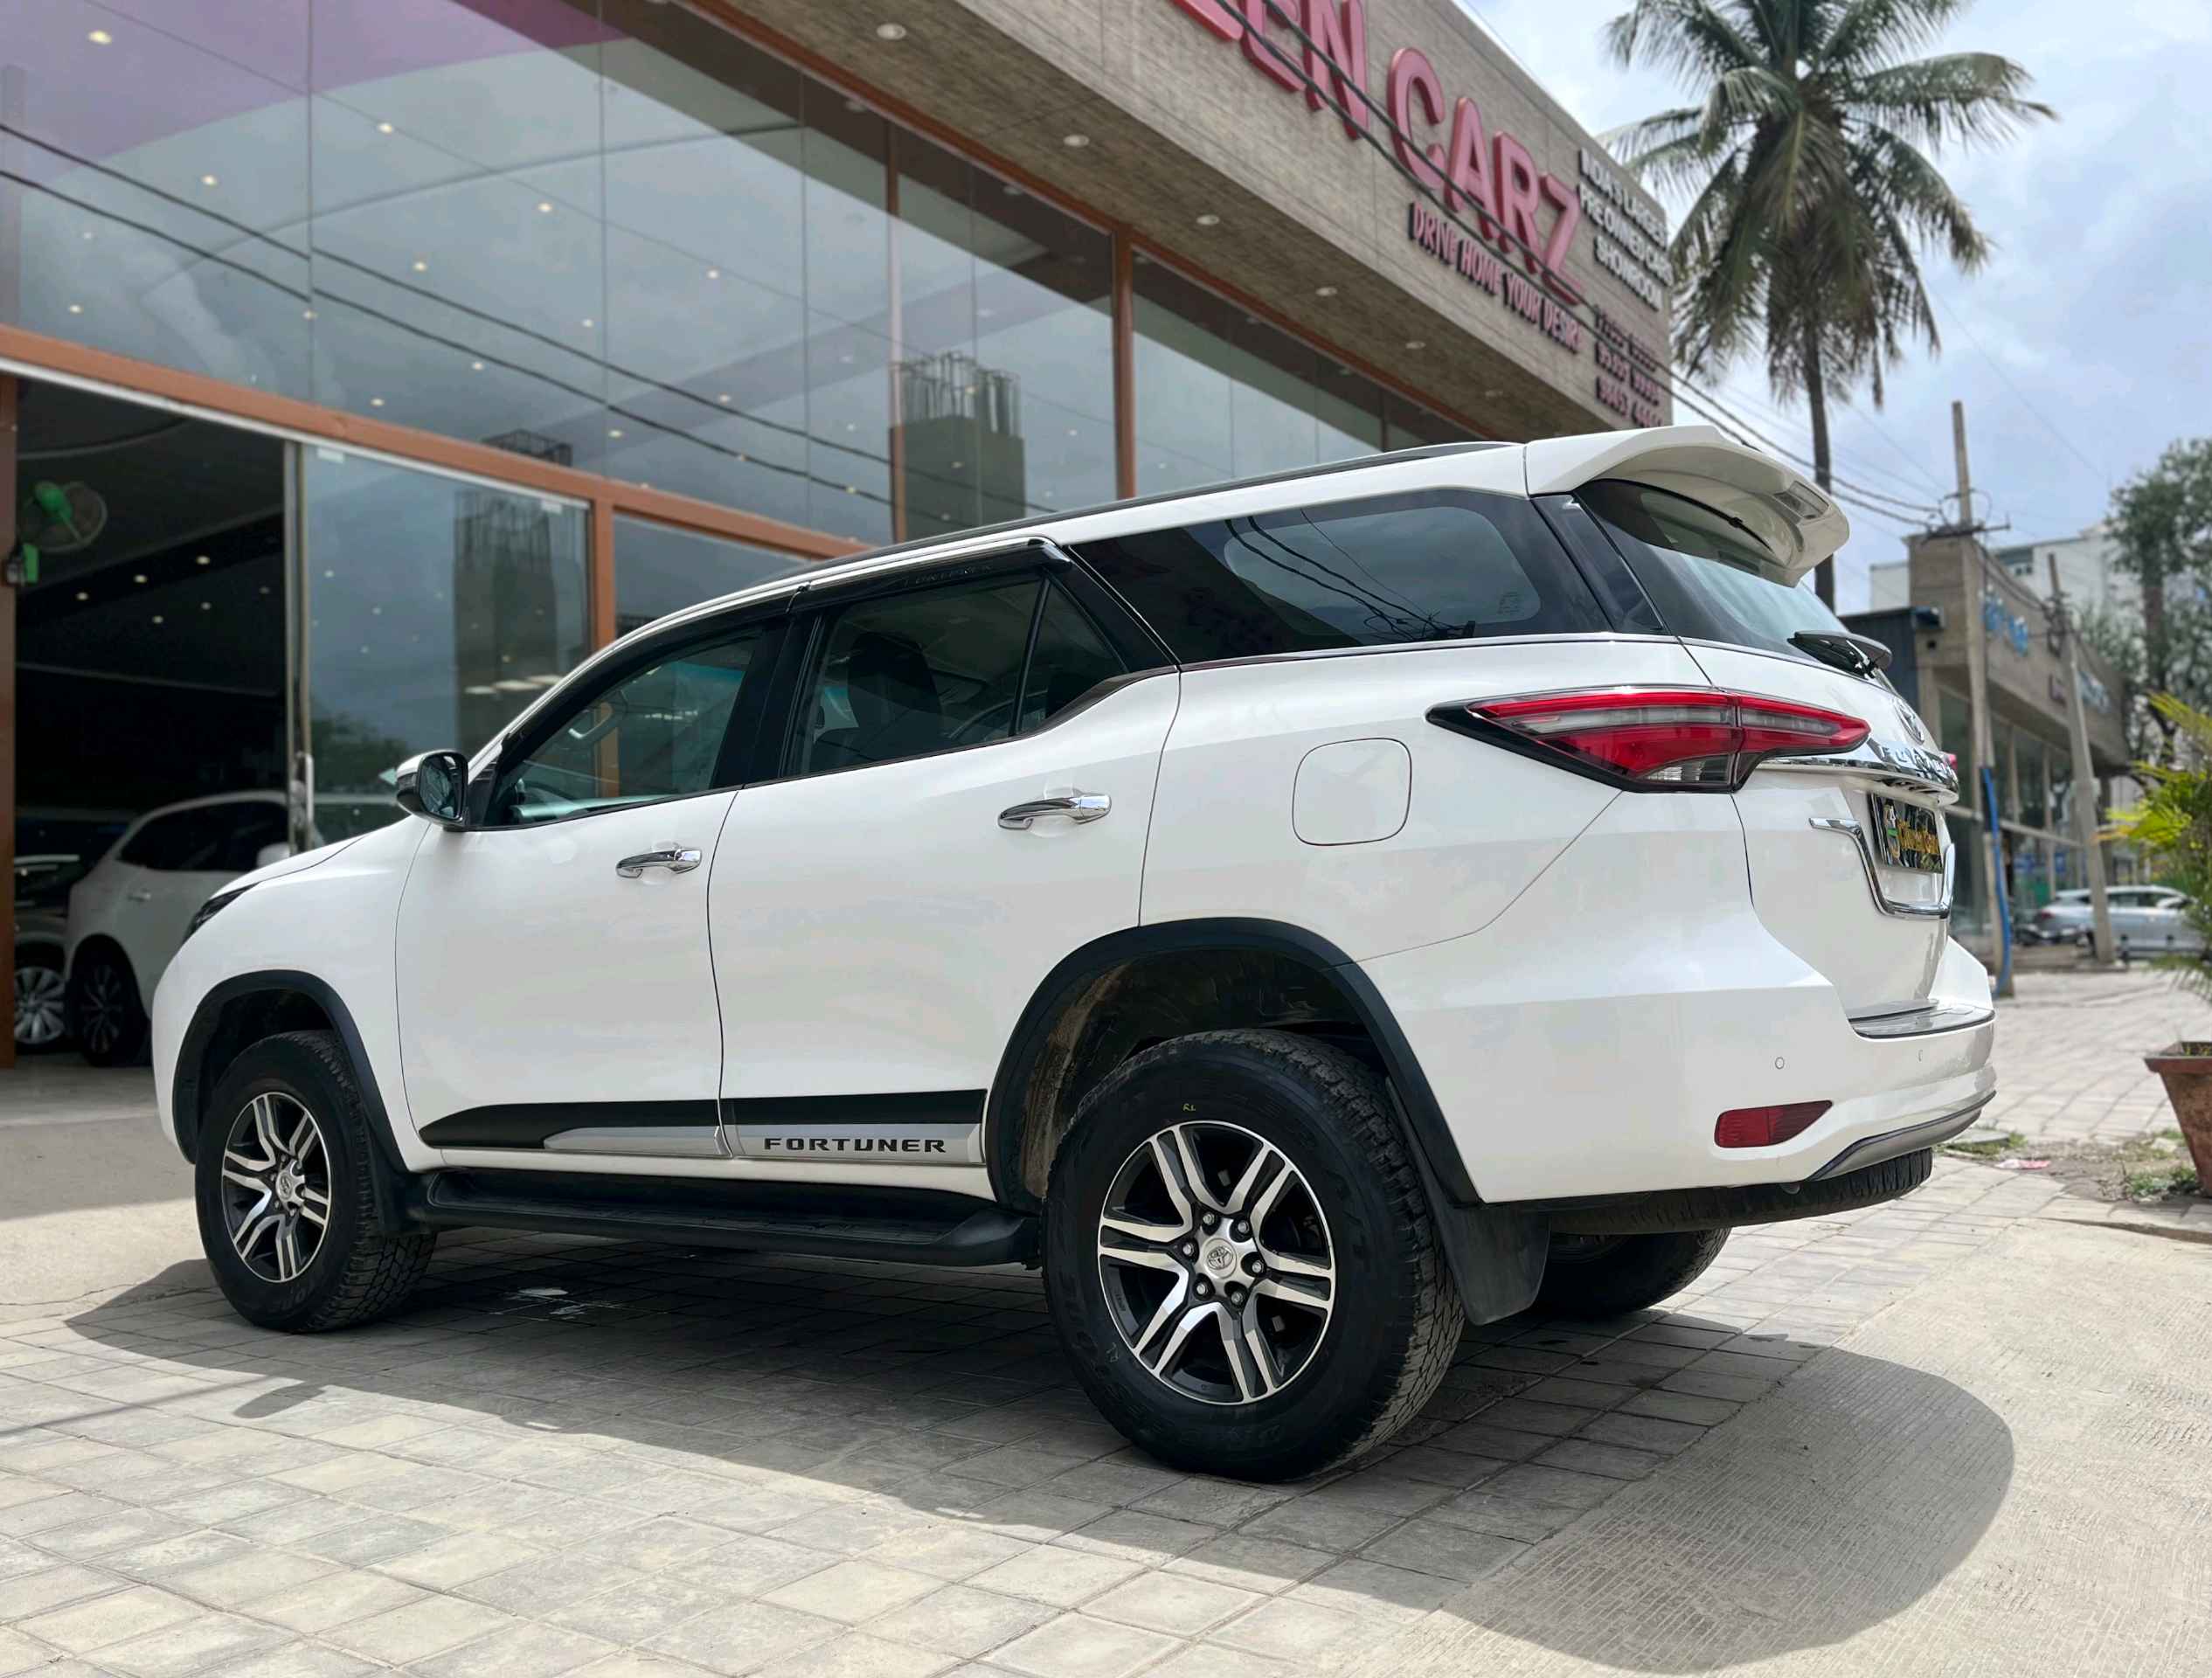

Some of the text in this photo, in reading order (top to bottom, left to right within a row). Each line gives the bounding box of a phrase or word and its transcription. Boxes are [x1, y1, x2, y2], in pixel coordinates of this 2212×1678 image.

[1387, 46, 1584, 306] CARZ
[1409, 201, 1457, 267] DRIVE
[1457, 238, 1502, 298] HOME
[1502, 271, 1542, 324] YOUR
[764, 1138, 947, 1153] FORTUNER
